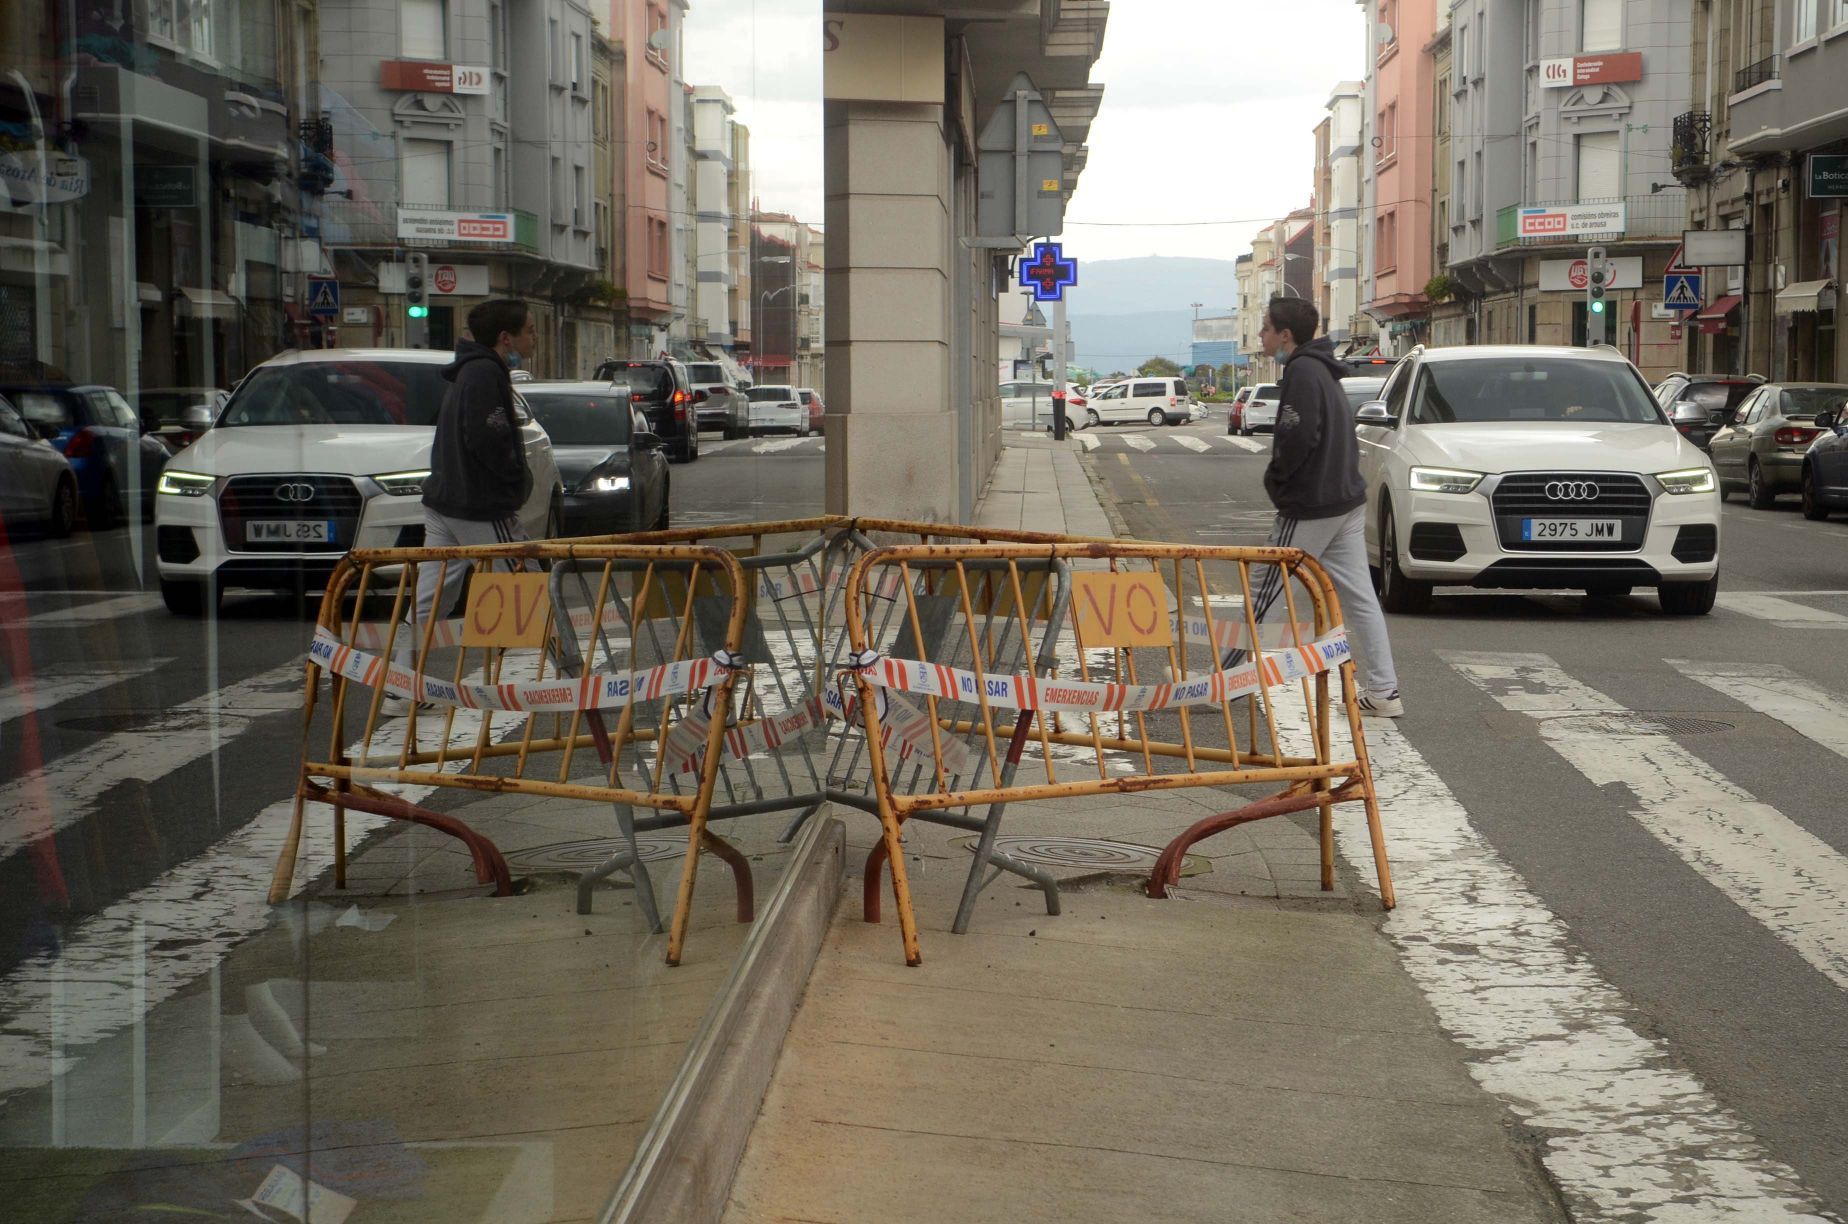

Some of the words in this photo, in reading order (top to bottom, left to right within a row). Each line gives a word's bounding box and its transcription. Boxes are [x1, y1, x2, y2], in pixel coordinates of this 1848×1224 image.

[1546, 63, 1567, 79] CIG
[1525, 217, 1564, 230] CCOO
[1538, 523, 1578, 537] 2975
[1585, 523, 1615, 537] JMW
[1083, 583, 1158, 635] VO
[1322, 645, 1335, 660] NO
[962, 676, 973, 693] NO
[1174, 687, 1184, 700] NO
[1185, 683, 1209, 697] PASAR
[1044, 687, 1100, 705] EMERXENCIAS
